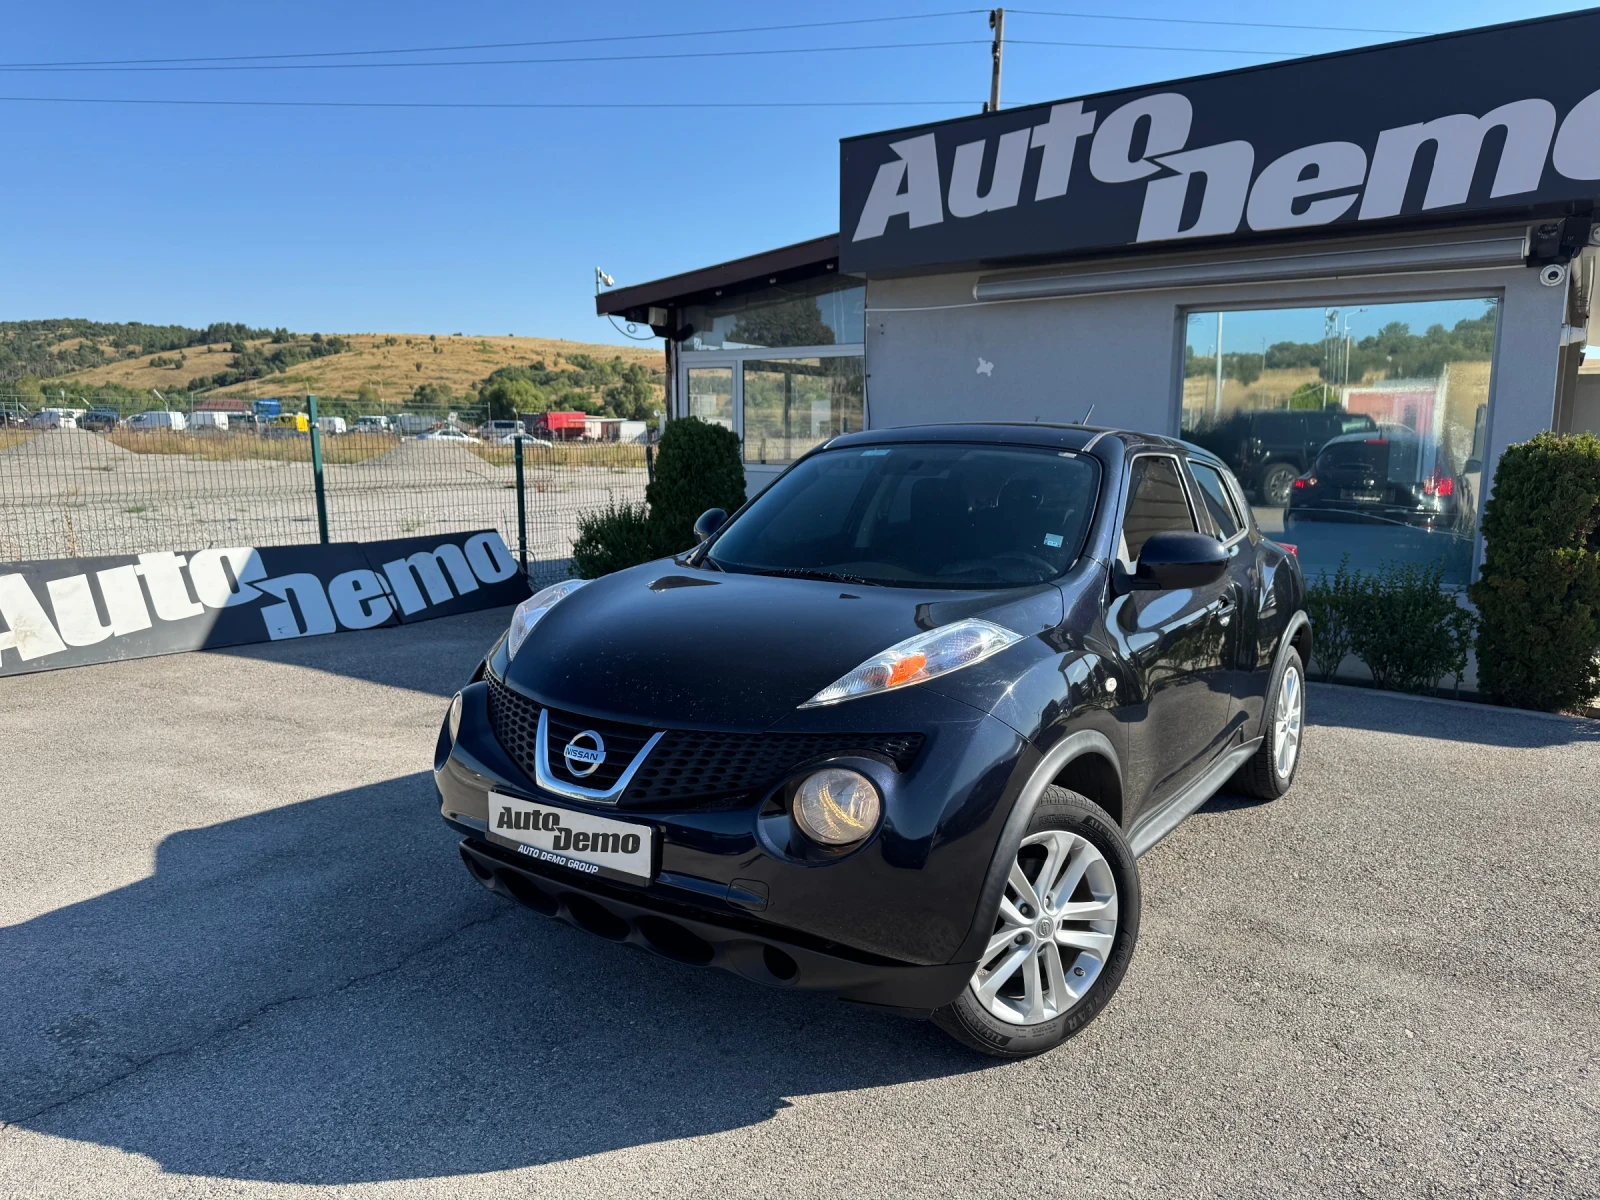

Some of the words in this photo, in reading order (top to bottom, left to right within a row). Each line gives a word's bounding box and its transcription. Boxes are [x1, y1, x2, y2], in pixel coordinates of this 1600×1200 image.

[852, 92, 1193, 242] Auto
[0, 547, 268, 667] Auto
[252, 532, 518, 641] Demo
[565, 746, 599, 761] NISSAN
[497, 806, 561, 832] Auto
[553, 826, 641, 854] Demo
[517, 844, 540, 858] AUTO
[540, 851, 567, 866] DEMO
[567, 860, 599, 874] GROUP
[1067, 942, 1129, 1032] GOODYEAR
